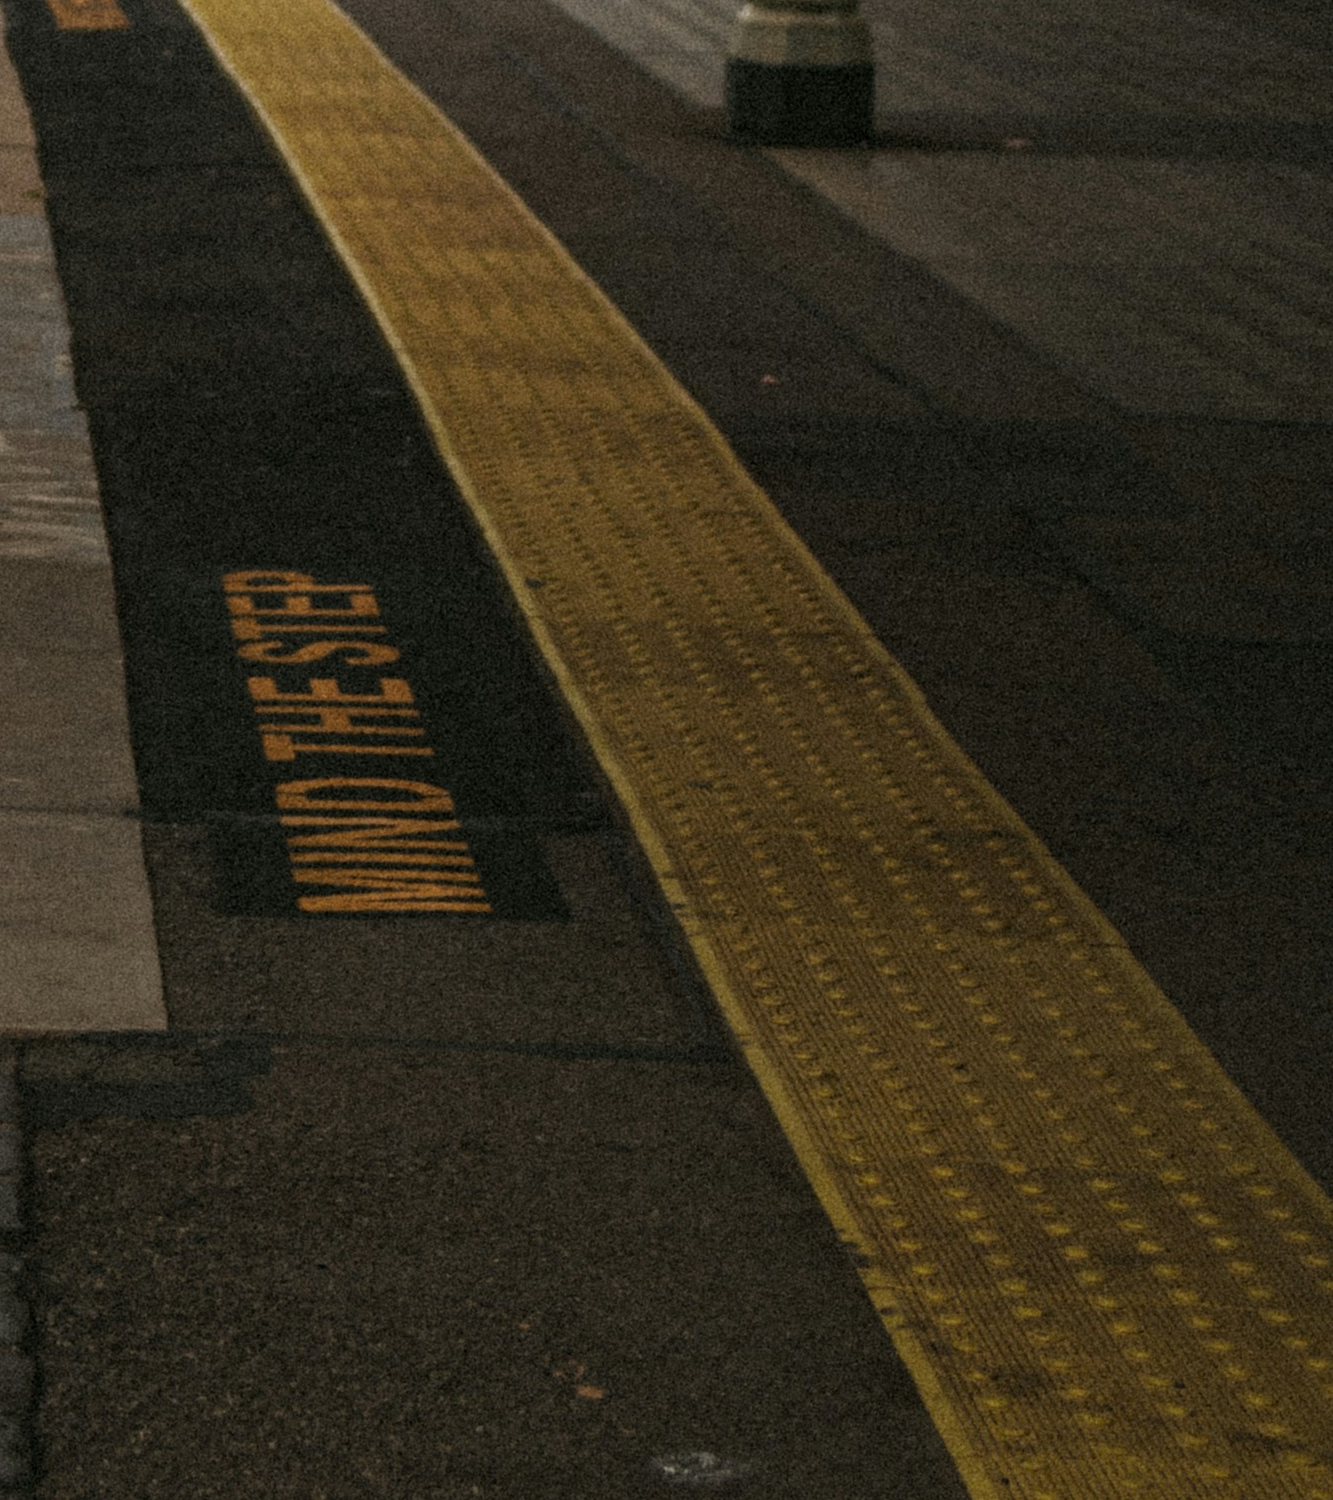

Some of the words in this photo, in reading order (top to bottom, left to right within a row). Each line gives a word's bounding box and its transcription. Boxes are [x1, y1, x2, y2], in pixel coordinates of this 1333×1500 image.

[223, 568, 409, 668] STEP
[247, 676, 435, 764] THE
[276, 776, 493, 915] MIND
